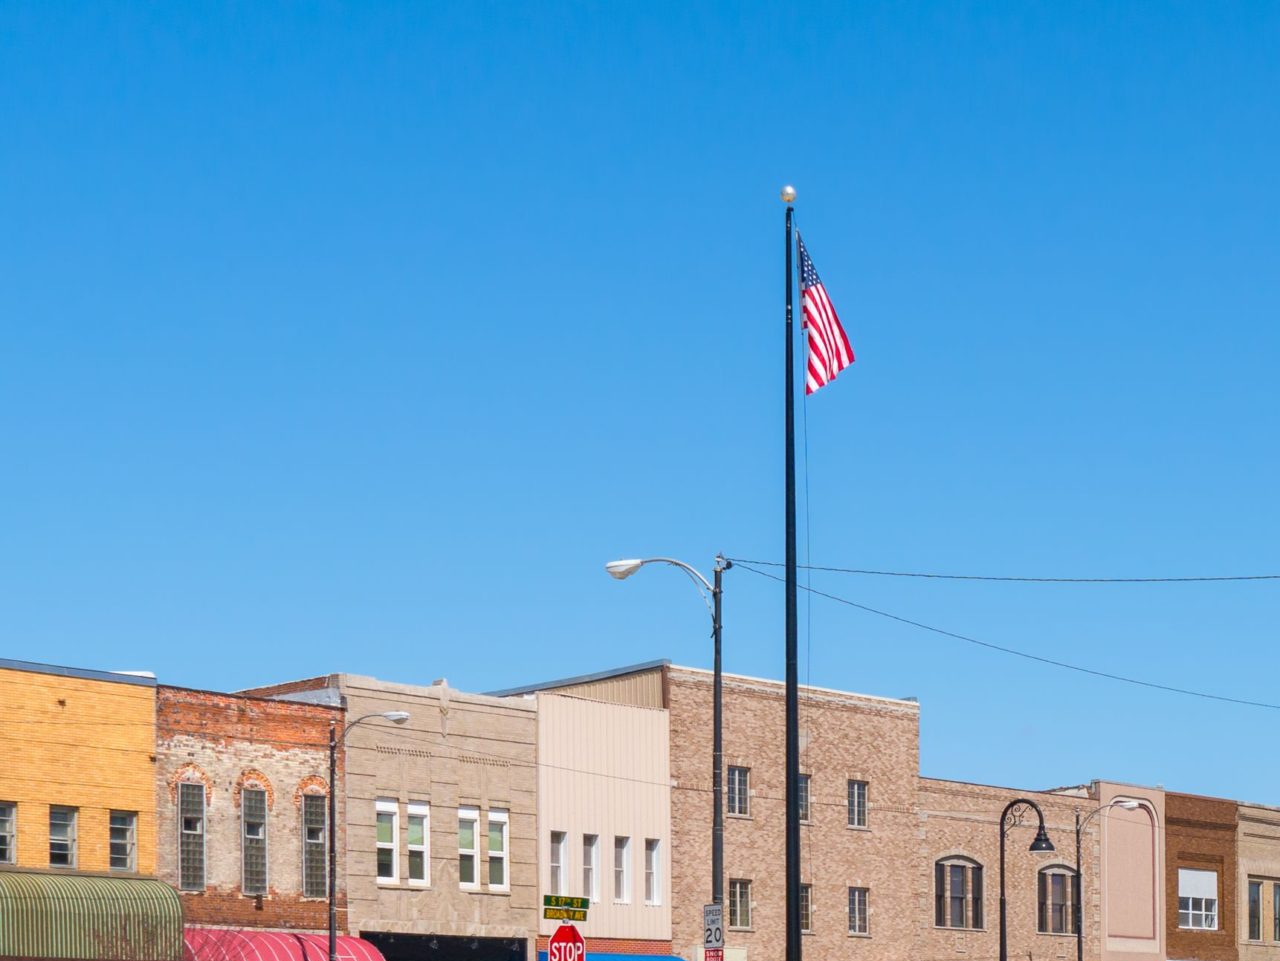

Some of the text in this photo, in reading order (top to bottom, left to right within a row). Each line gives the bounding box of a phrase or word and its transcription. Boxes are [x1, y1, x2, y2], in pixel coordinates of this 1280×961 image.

[573, 899, 582, 907] ST
[705, 909, 721, 917] SPEED
[707, 918, 720, 926] LIMIT
[705, 927, 722, 943] 20
